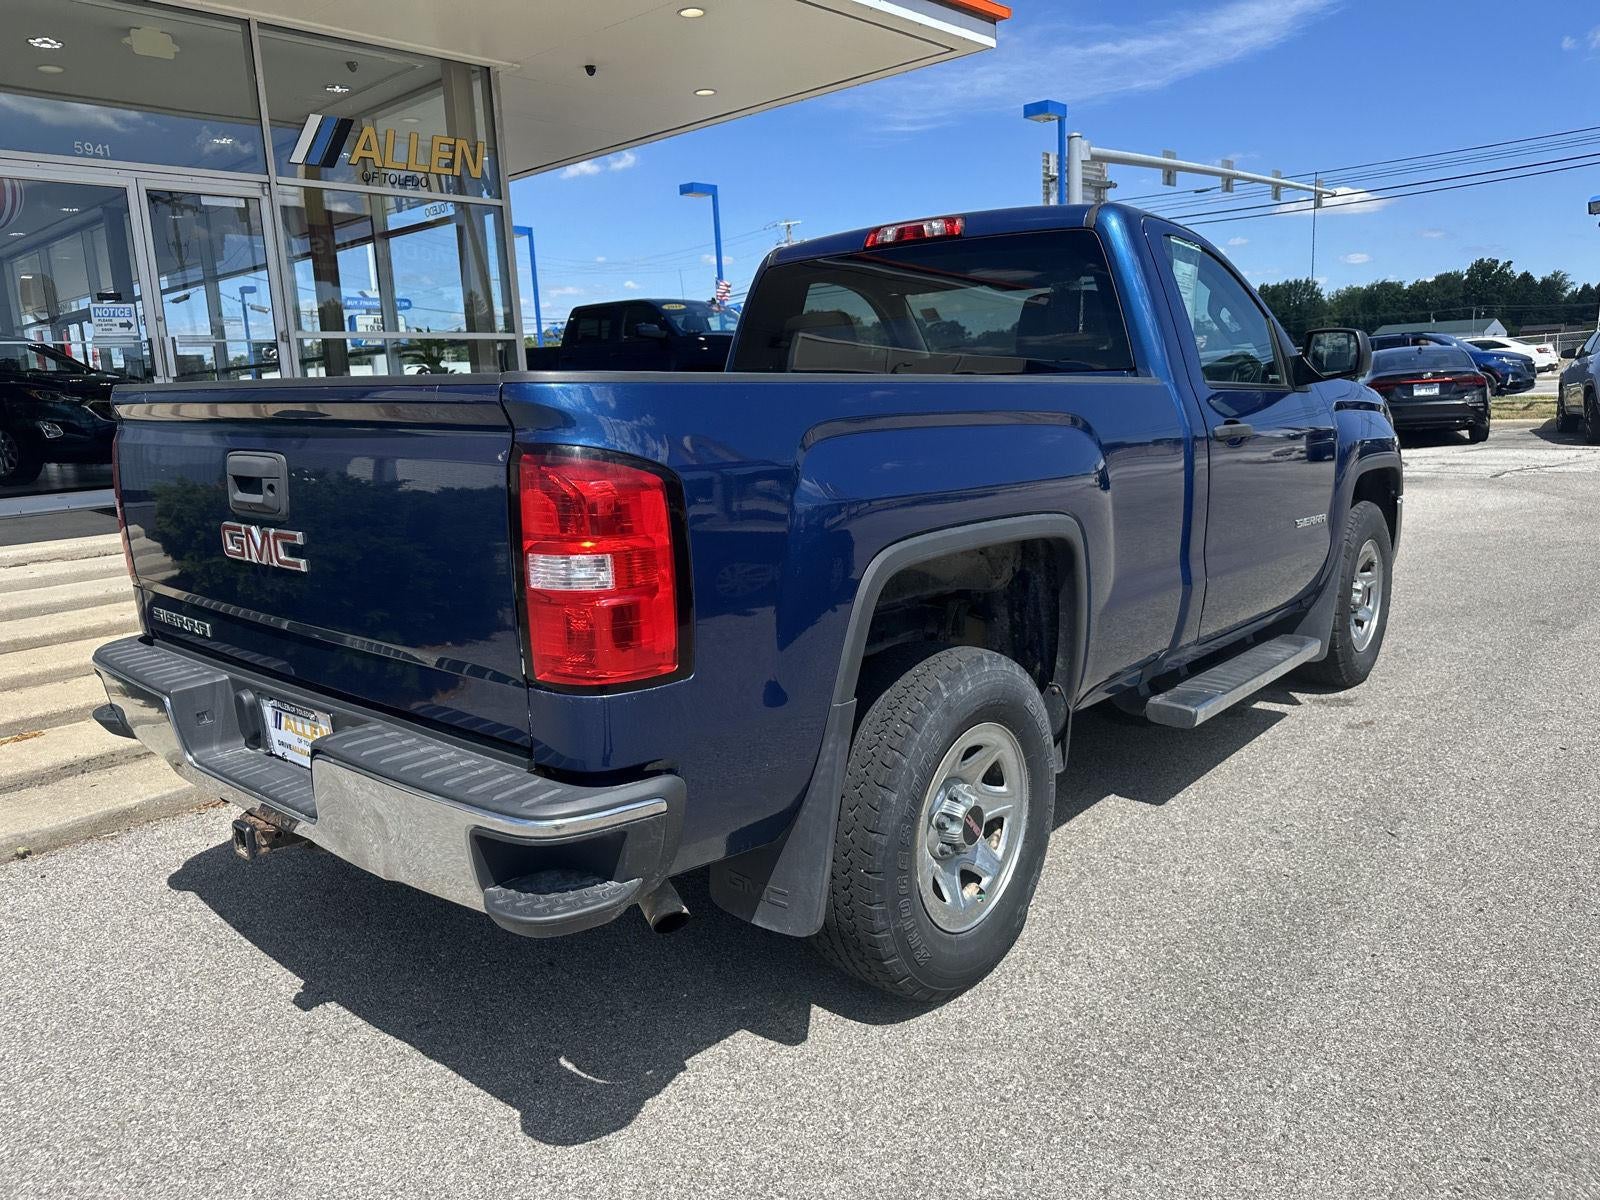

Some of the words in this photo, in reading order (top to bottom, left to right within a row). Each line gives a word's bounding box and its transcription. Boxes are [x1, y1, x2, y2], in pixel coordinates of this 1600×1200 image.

[74, 141, 111, 157] 5941
[348, 126, 485, 179] ALLEN
[362, 171, 379, 183] OF
[381, 172, 429, 188] TOLEDO
[95, 308, 131, 317] NOTICE
[1295, 513, 1327, 528] SIERRA
[221, 521, 307, 572] GMC
[152, 606, 211, 638] SIERRA
[965, 814, 981, 837] GMC
